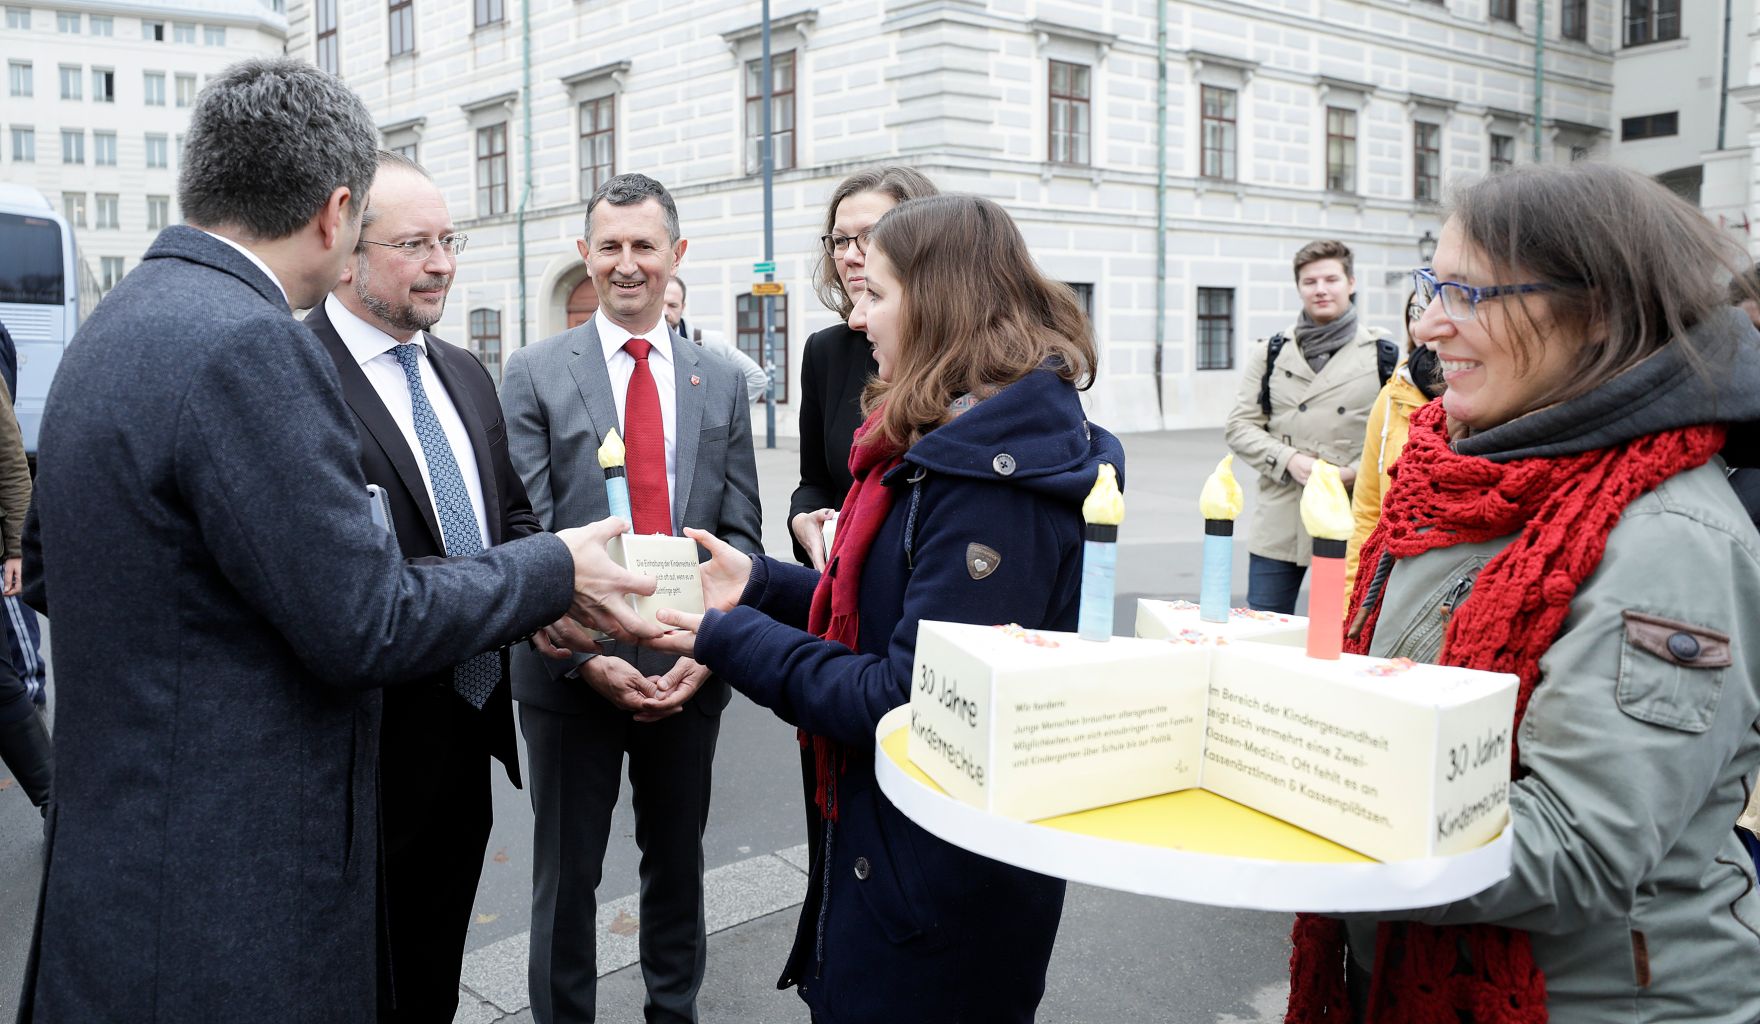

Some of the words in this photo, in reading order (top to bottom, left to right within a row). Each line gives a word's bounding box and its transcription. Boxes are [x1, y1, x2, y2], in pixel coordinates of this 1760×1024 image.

[919, 664, 935, 695] 30
[938, 675, 978, 728] Jahre
[1208, 683, 1219, 696] Im
[1222, 687, 1259, 709] Bereich
[1262, 702, 1280, 715] der
[1283, 706, 1389, 751] Kindergesundheit
[911, 708, 984, 787] Kinderrechte
[1014, 724, 1039, 735] Junge
[1041, 718, 1080, 729] Menschen
[1207, 707, 1230, 724] zeigt
[1232, 715, 1252, 730] sich
[1255, 726, 1303, 747] vermehrt
[1306, 739, 1330, 756] eine
[1334, 746, 1368, 767] Zwei-
[1013, 758, 1028, 768] und
[1031, 751, 1081, 764] Kindergarten
[1102, 743, 1125, 753] Schule
[1292, 756, 1311, 773] Oft
[1314, 764, 1341, 784] fehlt
[1344, 779, 1358, 791] es
[1361, 783, 1378, 797] an
[1446, 743, 1469, 781] 30
[1289, 778, 1297, 792] &
[1299, 783, 1393, 829] Kassenplätzen.
